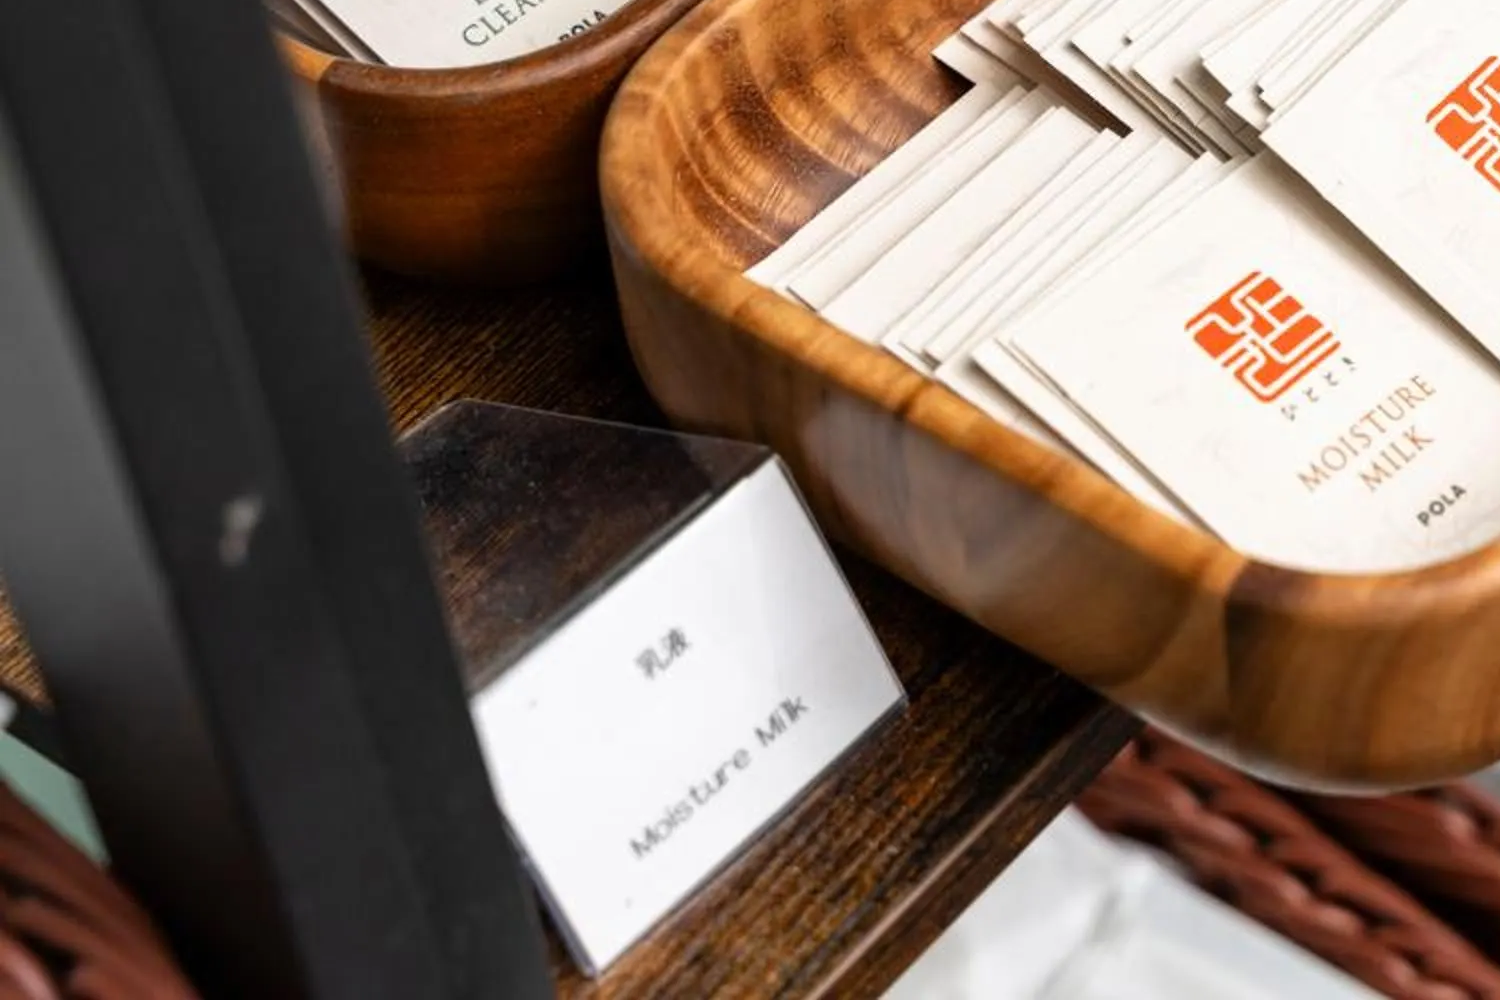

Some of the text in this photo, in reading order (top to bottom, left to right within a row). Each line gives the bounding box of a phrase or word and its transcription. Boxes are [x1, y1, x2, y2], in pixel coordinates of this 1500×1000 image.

[1297, 375, 1436, 493] MOISTURE
[1358, 425, 1435, 493] MILK
[1417, 484, 1466, 527] POLA
[636, 627, 690, 679] 乳液
[629, 696, 808, 858] Moisture Milk
